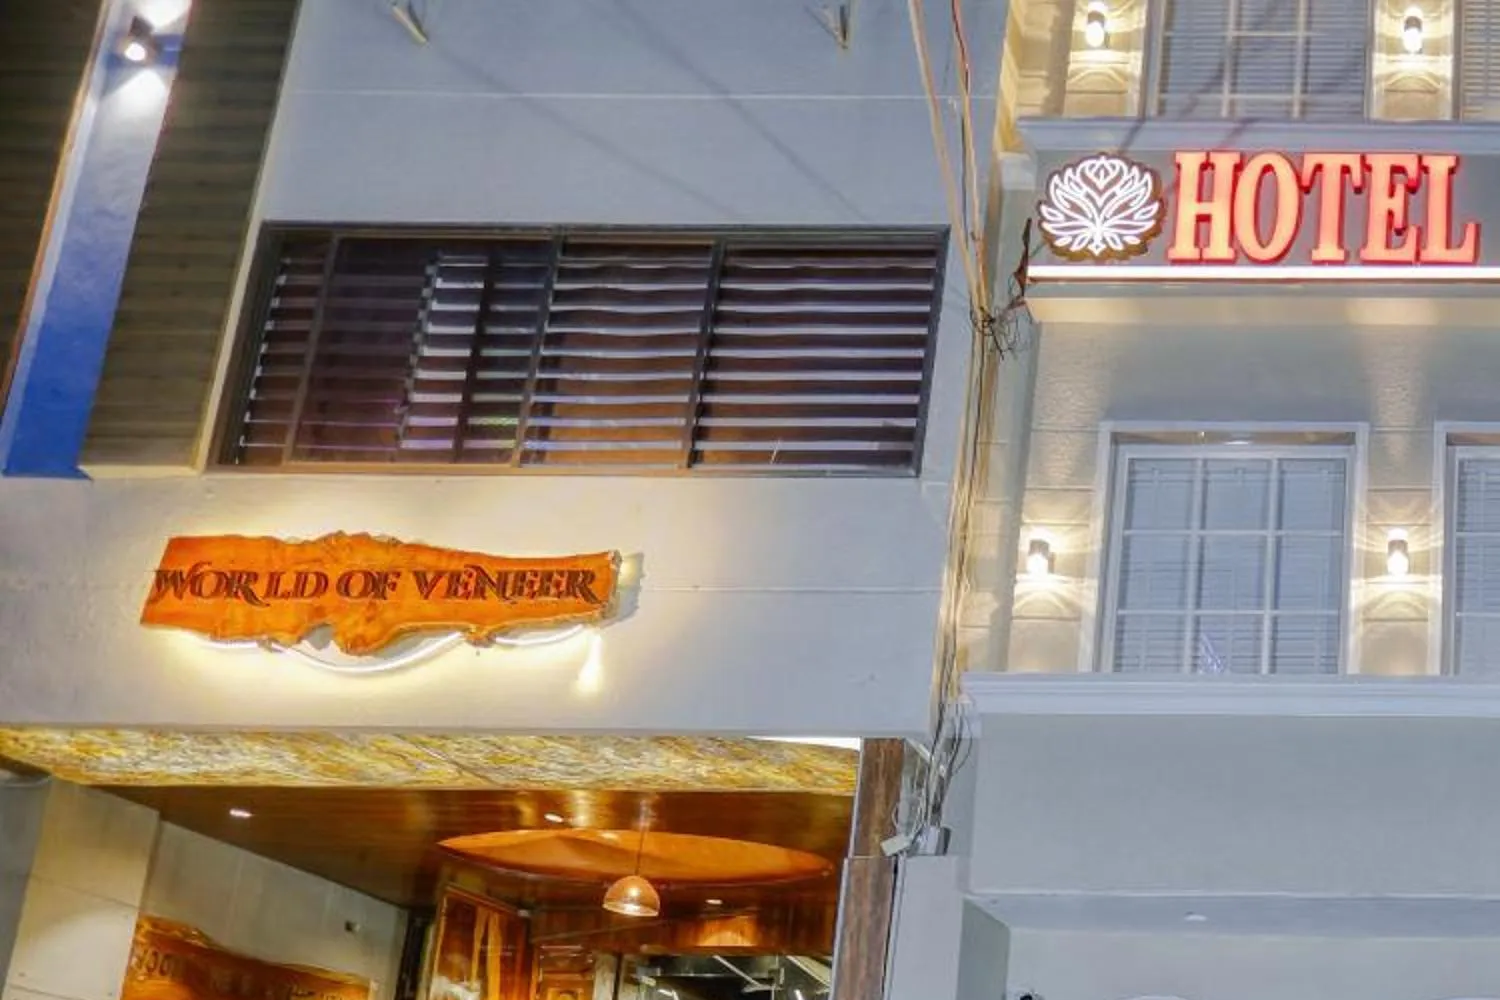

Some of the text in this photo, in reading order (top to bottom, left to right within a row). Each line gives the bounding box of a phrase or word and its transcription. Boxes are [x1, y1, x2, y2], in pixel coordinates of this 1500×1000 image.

[1166, 150, 1480, 266] HOTEL
[153, 561, 606, 608] WORLD OF VENEER
